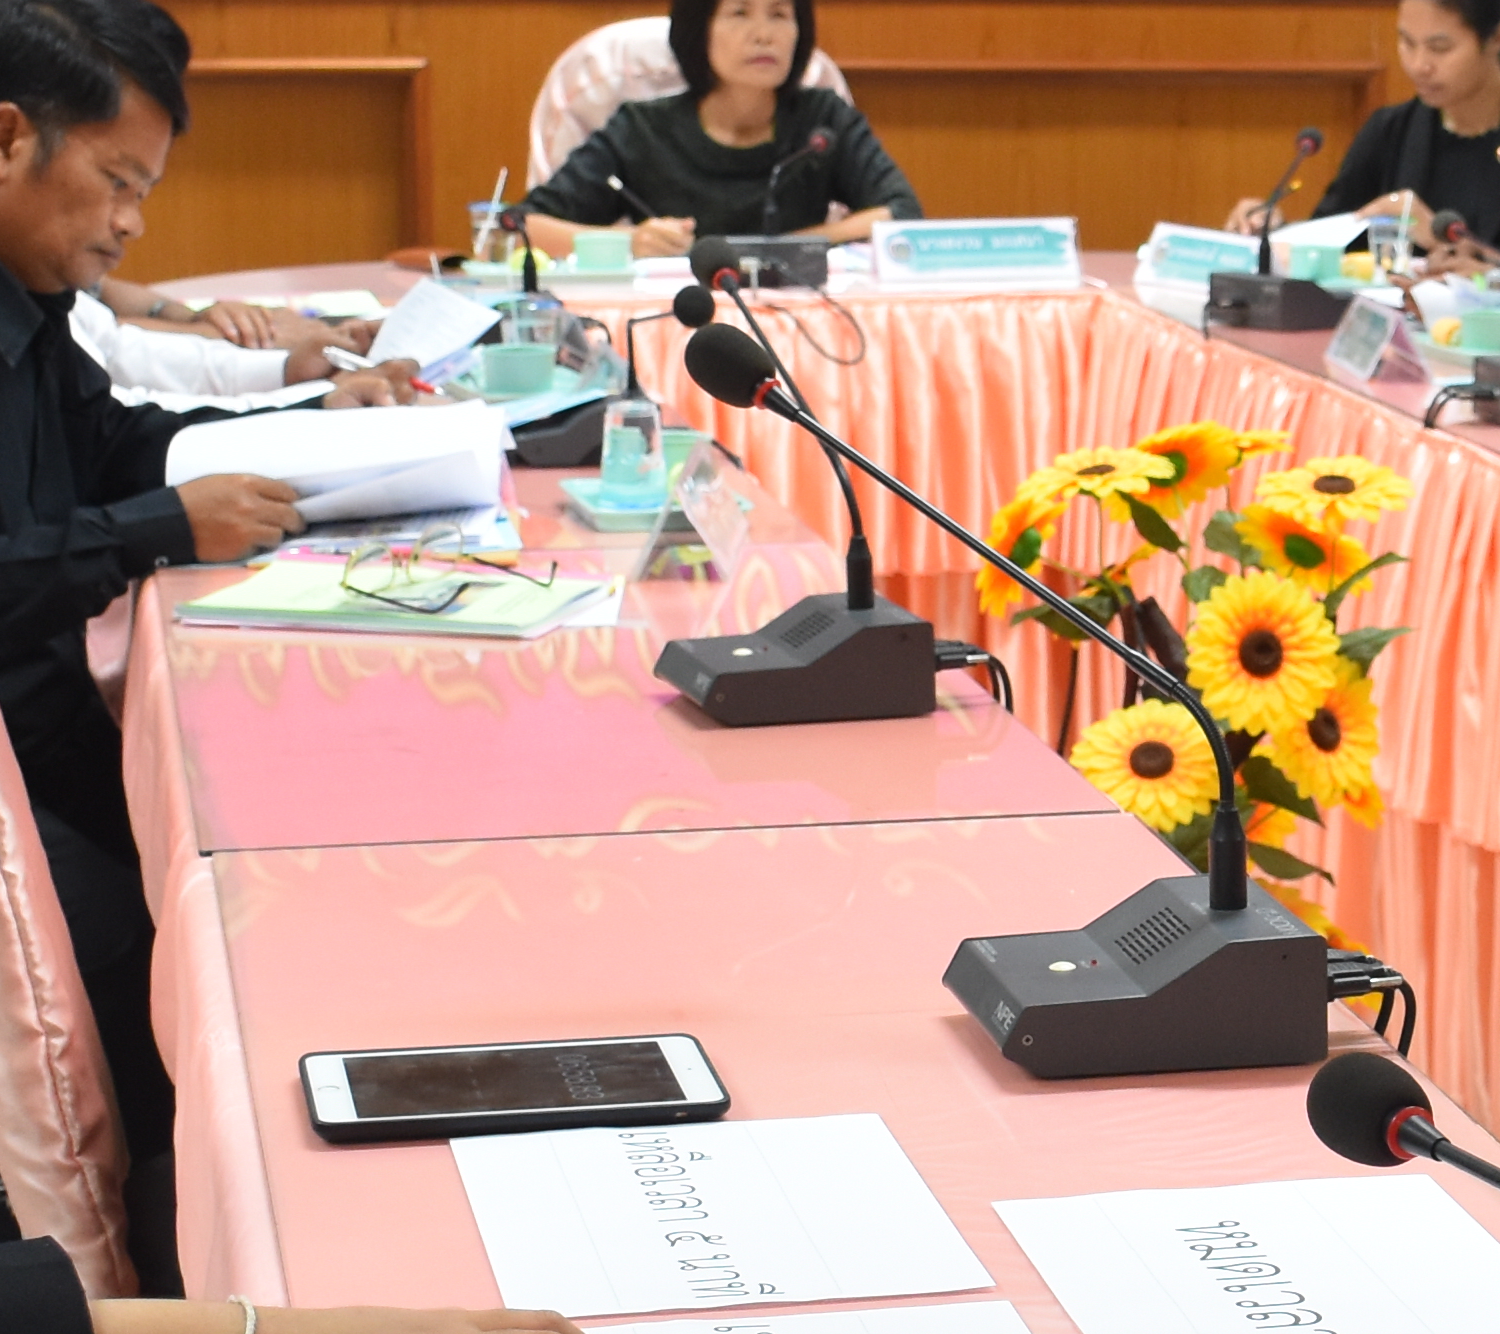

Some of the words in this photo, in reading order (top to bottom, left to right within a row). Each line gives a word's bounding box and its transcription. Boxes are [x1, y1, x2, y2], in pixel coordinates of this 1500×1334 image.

[993, 999, 1017, 1032] NPE
[618, 1131, 712, 1223] เหลือเวลา
[677, 1253, 786, 1299] นาที
